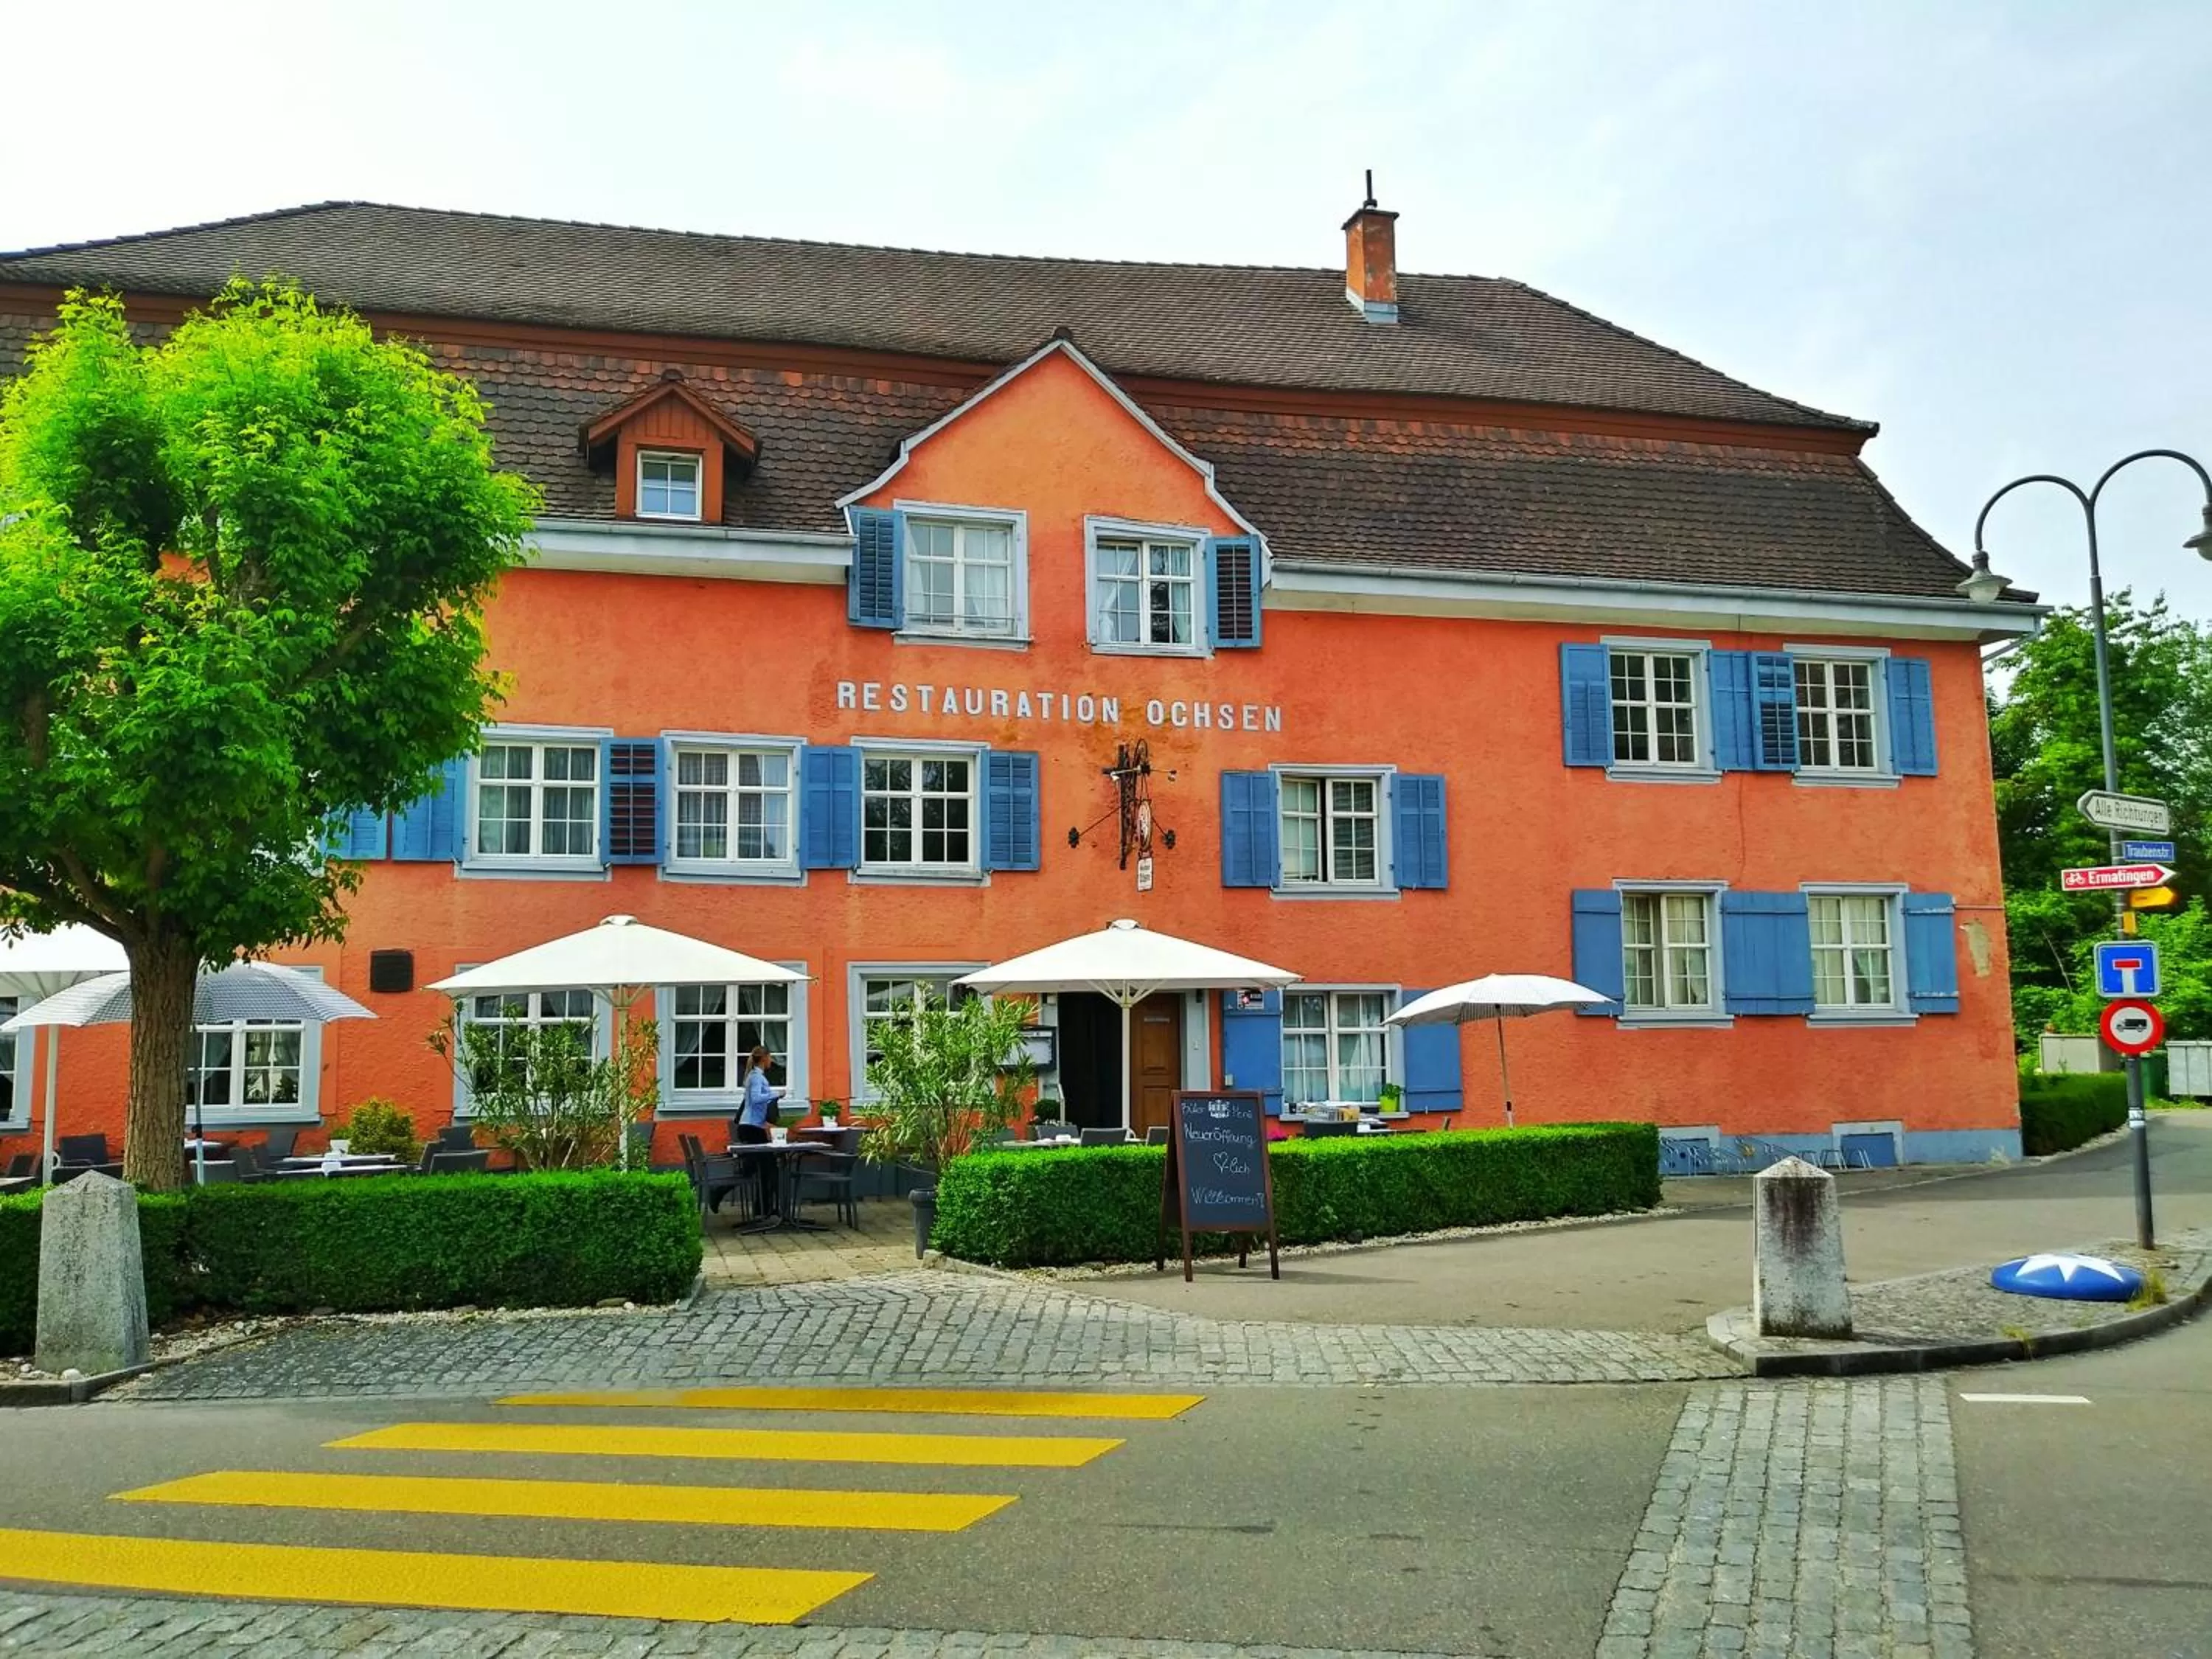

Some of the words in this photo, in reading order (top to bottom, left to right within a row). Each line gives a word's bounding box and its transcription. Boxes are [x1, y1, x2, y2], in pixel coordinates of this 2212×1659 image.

[837, 681, 1120, 723] RESTAURATION
[1147, 698, 1282, 732] OCHSEN
[2095, 799, 2112, 818] Alle
[2114, 801, 2165, 827] Richtungen
[2087, 870, 2155, 885] Ermatingen
